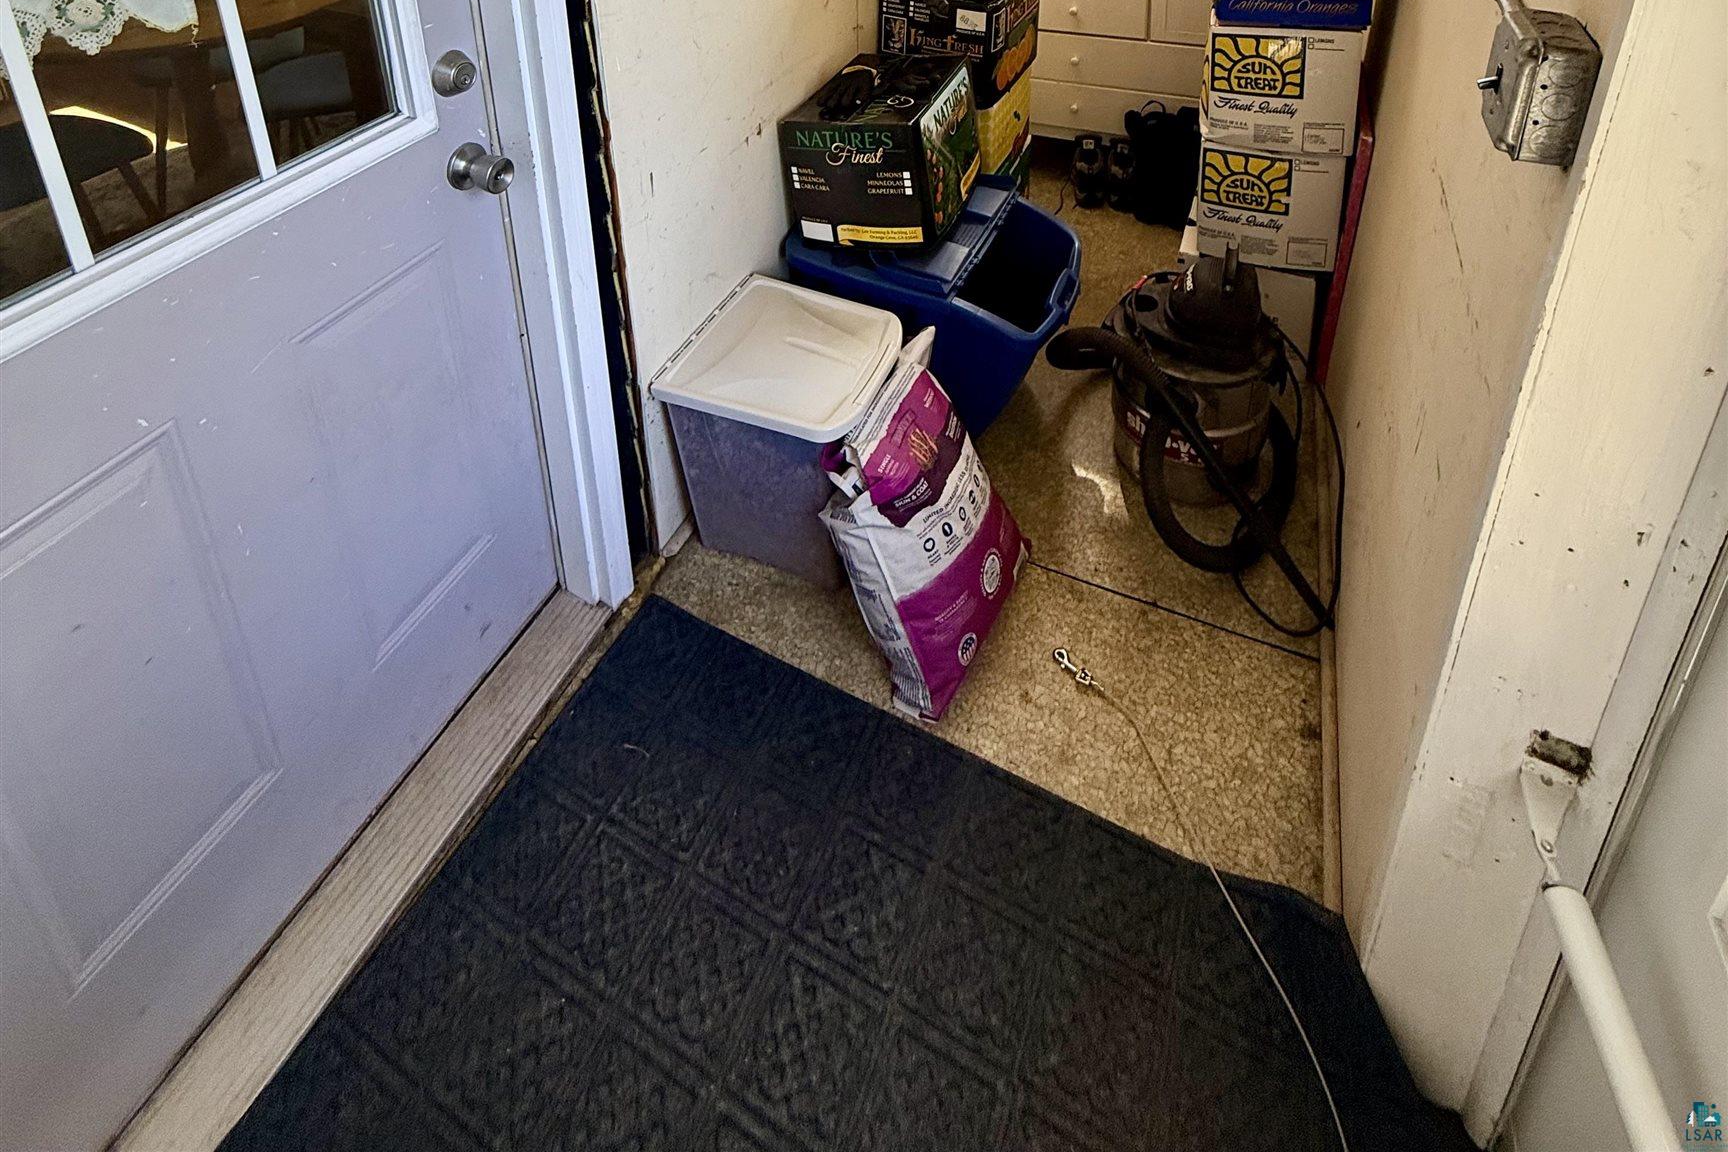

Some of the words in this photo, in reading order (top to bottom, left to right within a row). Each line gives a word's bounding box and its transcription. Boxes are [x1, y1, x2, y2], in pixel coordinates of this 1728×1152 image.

[1297, 0, 1358, 15] Oranges
[909, 28, 942, 48] KING
[942, 35, 984, 55] FRESH
[1236, 61, 1276, 76] SUN
[1234, 76, 1280, 91] TREAT
[1214, 96, 1255, 111] Finest
[1254, 100, 1298, 119] Quality
[795, 130, 893, 149] NATURE'S
[825, 142, 884, 166] Finest
[1225, 177, 1264, 193] SUN
[1223, 189, 1267, 208] TREAT
[1203, 206, 1243, 223] Finest
[1241, 214, 1283, 233] Quality
[923, 508, 944, 524] LIMITED
